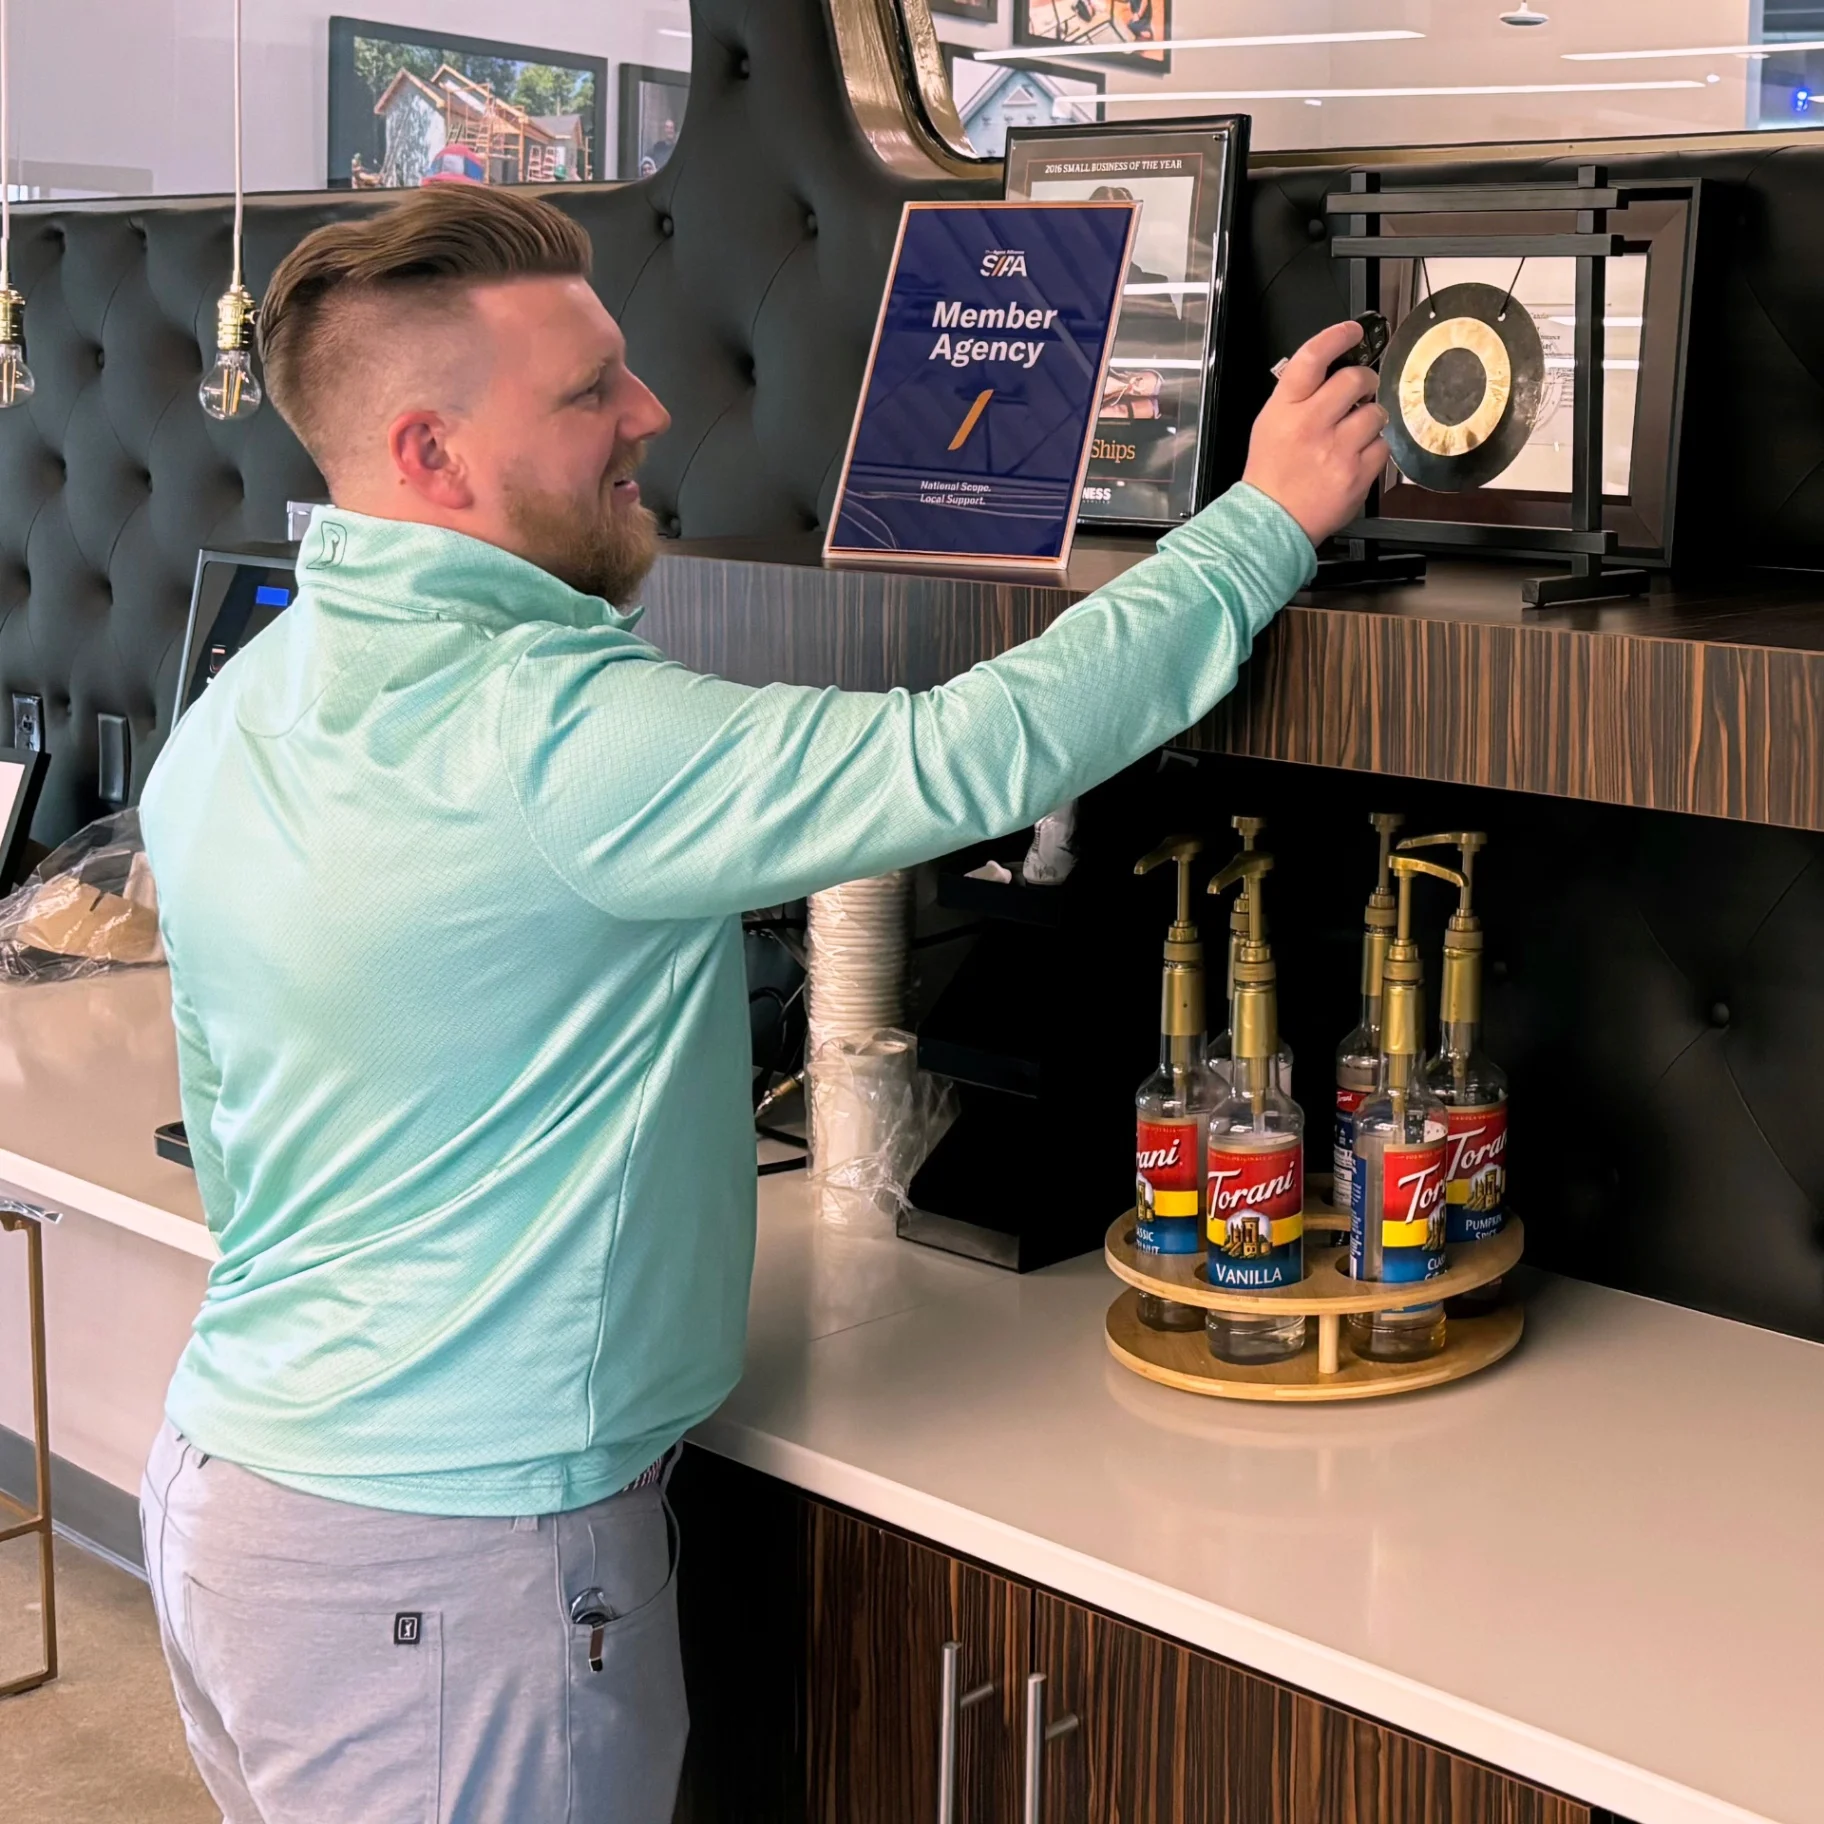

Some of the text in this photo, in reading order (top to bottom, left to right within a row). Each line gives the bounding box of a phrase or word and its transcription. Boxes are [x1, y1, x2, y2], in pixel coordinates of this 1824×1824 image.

[1045, 159, 1182, 174] 2016 SMALL BUSINESS OF THE YEAR
[931, 301, 1058, 330] Member
[928, 333, 1045, 368] Agency
[1090, 439, 1136, 463] Ships
[920, 481, 992, 493] National Scope.
[920, 494, 986, 506] Local Support.
[1207, 1161, 1295, 1219] Torani
[1397, 1161, 1446, 1225] Tor
[1215, 1263, 1282, 1285] VANILLA
